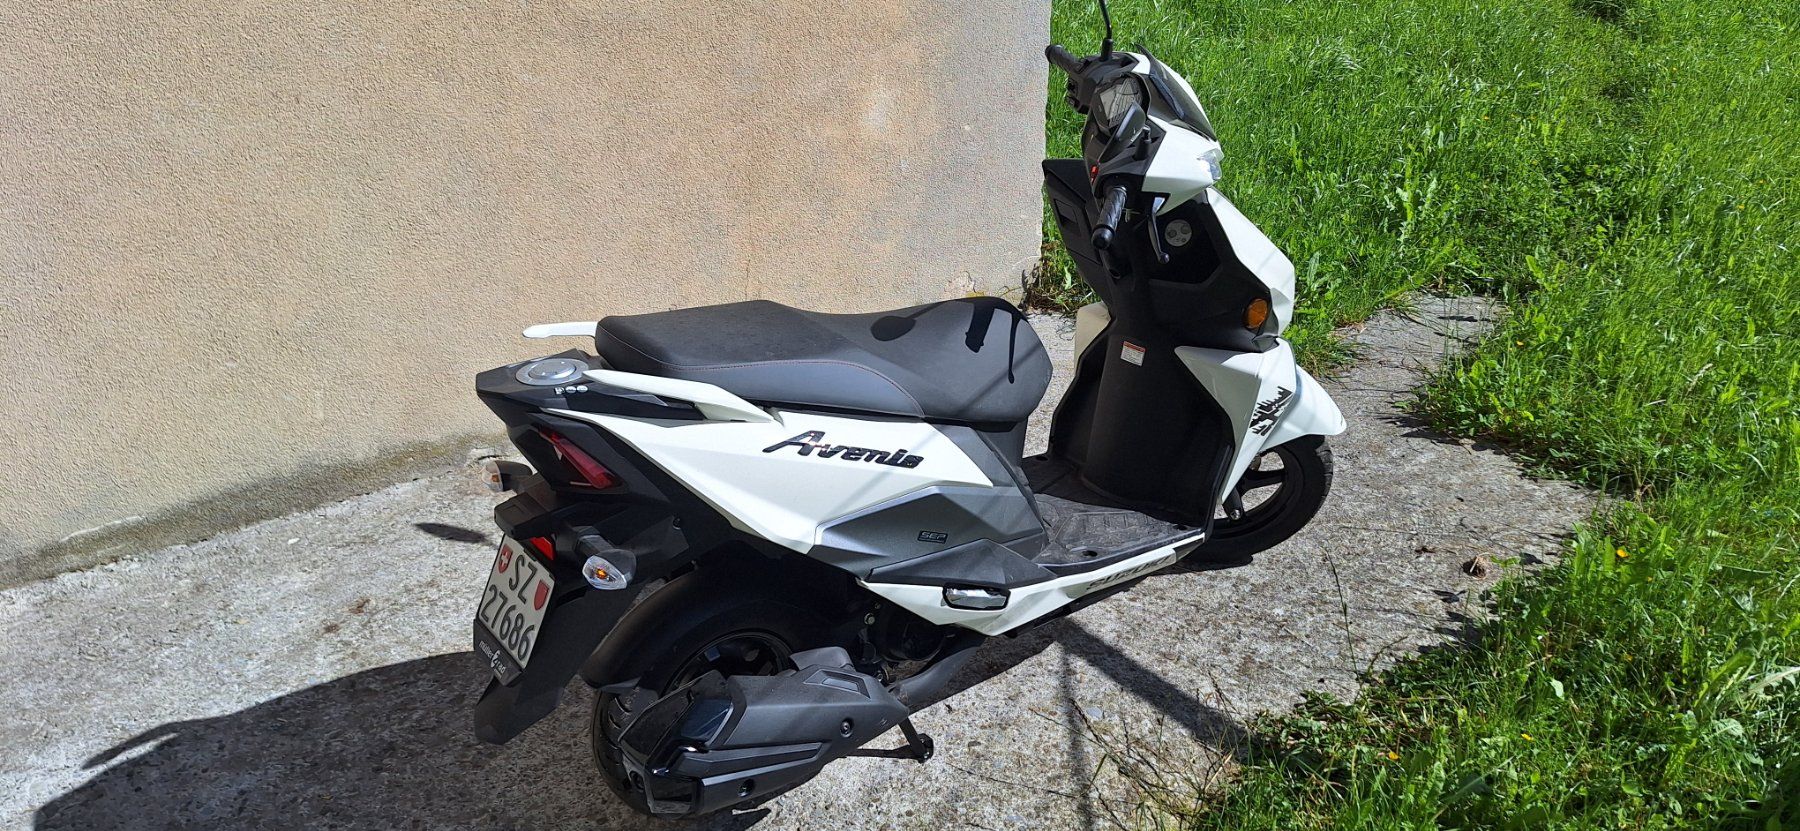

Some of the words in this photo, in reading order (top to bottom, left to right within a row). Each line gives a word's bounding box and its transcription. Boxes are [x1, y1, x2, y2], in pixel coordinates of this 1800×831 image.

[762, 430, 924, 469] Avenis
[508, 554, 538, 604] SZ
[480, 584, 535, 662] 27686
